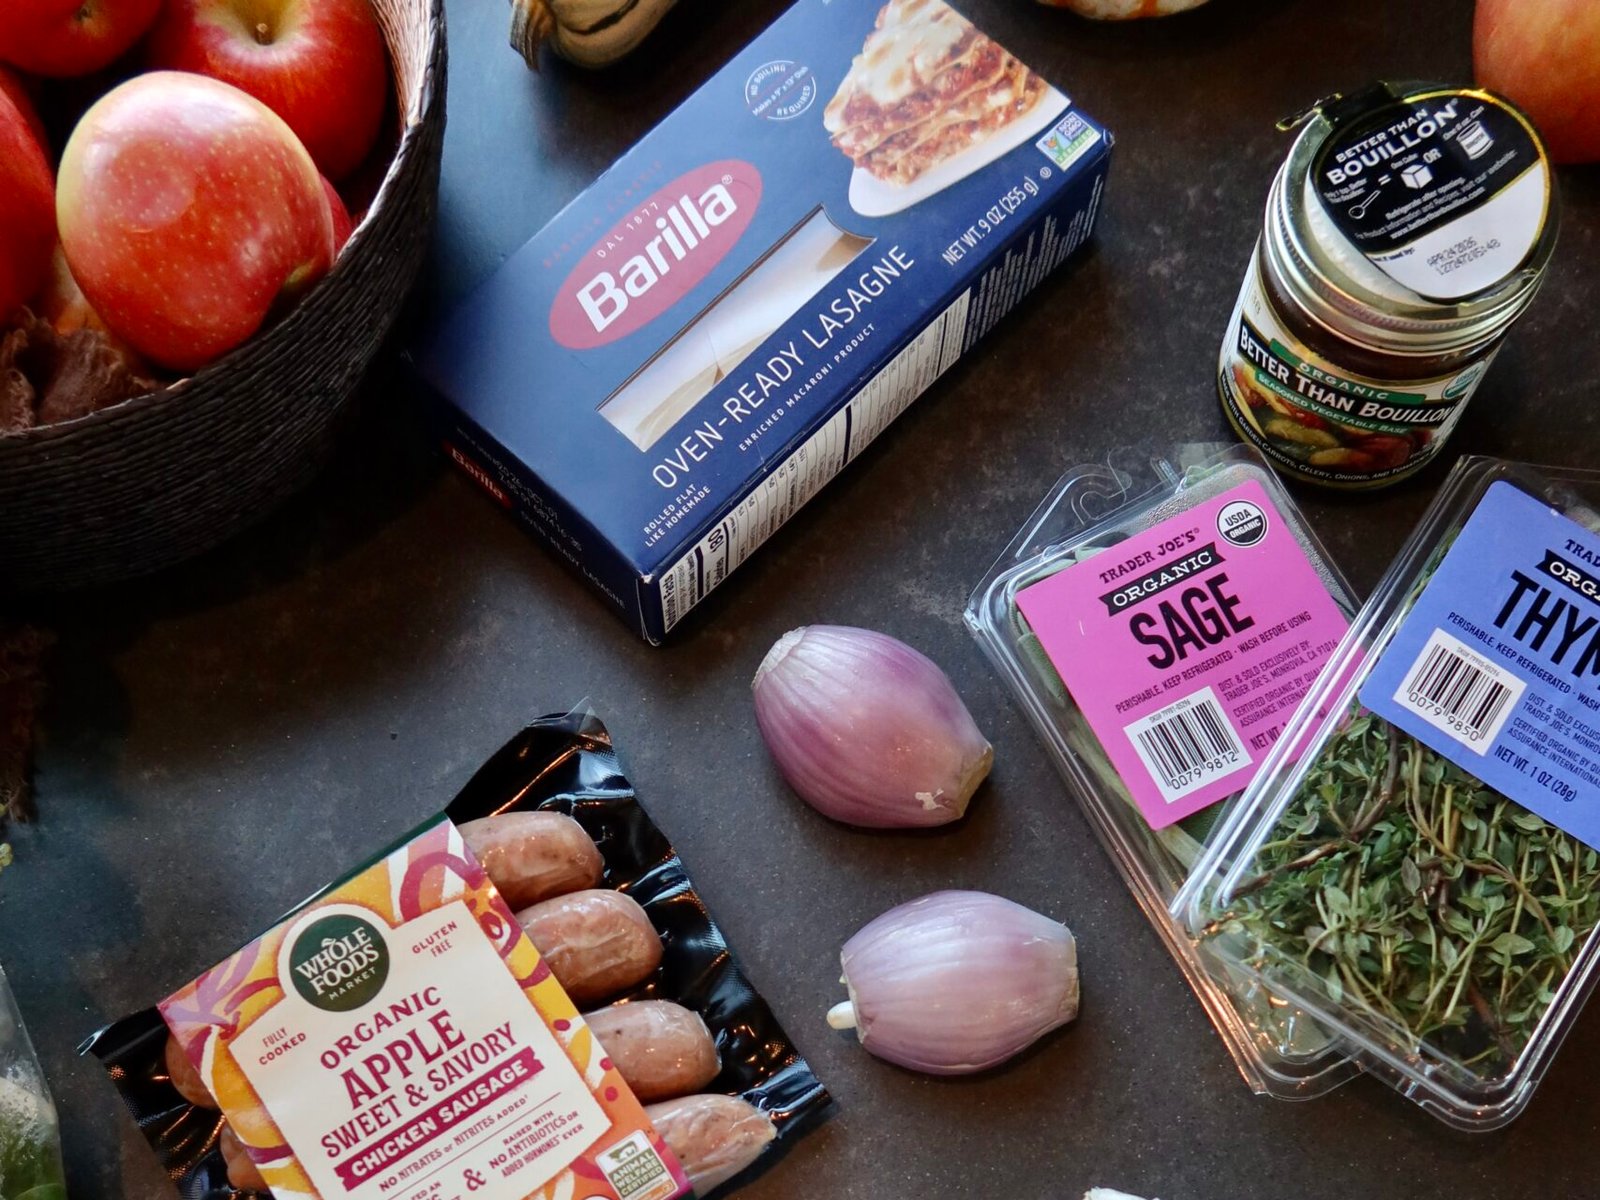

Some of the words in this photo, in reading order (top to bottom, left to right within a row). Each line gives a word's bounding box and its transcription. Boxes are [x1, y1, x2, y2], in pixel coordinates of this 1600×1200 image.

[1326, 103, 1457, 185] BOUILLON
[1335, 132, 1387, 163] BETTER
[1387, 108, 1428, 135] THAN
[1422, 148, 1442, 164] OR
[596, 234, 624, 258] DAL
[626, 201, 659, 230] 1877
[942, 240, 967, 266] NET
[960, 225, 985, 248] WT.
[978, 219, 992, 233] 9
[988, 204, 1007, 227] OZ
[998, 186, 1027, 214] (255
[577, 184, 736, 331] Barilla
[652, 342, 804, 488] OVEN-READY
[802, 245, 914, 349] LASAGNE
[738, 408, 785, 451] ENRICHED
[785, 363, 833, 408] MACARONI
[833, 323, 875, 363] PRODUCT
[1240, 325, 1289, 384] BETTER
[1295, 373, 1355, 412] THAN
[1359, 402, 1454, 423] BOUILLON
[1297, 361, 1388, 399] ORGANIC
[1258, 373, 1308, 407] SEASONED
[1310, 403, 1377, 429] VEGETABLE
[1378, 424, 1408, 434] BASE
[643, 504, 676, 535] ROLLED
[675, 483, 696, 505] FLAT
[644, 527, 666, 547] LIKE
[665, 485, 711, 529] HOMEMADE
[1224, 509, 1252, 527] USDA
[1229, 518, 1261, 539] ORGANIC
[1099, 551, 1156, 584] TRADER
[1157, 530, 1196, 556] JOE'S
[1113, 551, 1212, 607] ORGANIC
[1549, 561, 1600, 601] ORG
[1130, 573, 1254, 669] SAGE
[1115, 684, 1164, 714] PERISHABLE,
[1161, 674, 1181, 690] KEEP
[1181, 650, 1233, 681] REFRIGERATED
[1237, 637, 1261, 653] WASH
[1258, 622, 1289, 644] BEFORE
[1286, 610, 1312, 629] USING
[1223, 683, 1251, 702] TRADER
[1306, 650, 1318, 661] CA
[1241, 665, 1261, 681] SOLD
[1258, 644, 1300, 672] EXCLUSIVELY
[1495, 642, 1518, 659] KEEP
[1516, 655, 1571, 694] REFRIGERATED
[1232, 696, 1266, 718] CERTIFIED
[1264, 681, 1295, 703] ORGANIC
[1293, 677, 1304, 688] BY
[1239, 703, 1278, 728] ASSURANCE
[1408, 691, 1443, 717] 0079
[1447, 715, 1481, 742] 9850
[1523, 701, 1551, 723] TRADER
[1553, 707, 1574, 725] SOLD
[1249, 732, 1269, 751] NET
[1507, 727, 1549, 757] ASSURANCE
[1513, 716, 1549, 743] CERTIFIED
[1547, 738, 1581, 762] ORGANIC
[1578, 756, 1591, 768] BY
[1169, 767, 1202, 790] 0079
[1206, 749, 1238, 772] 9812
[1494, 744, 1516, 763] NET
[1512, 755, 1530, 774] WT.
[1529, 766, 1538, 778] 1
[1537, 771, 1553, 788] OZ
[1550, 779, 1578, 802] (28g)
[295, 927, 371, 979] WHOLE
[412, 921, 458, 954] GLUTEN
[430, 939, 452, 957] FREE
[310, 943, 379, 995] FOODS
[328, 966, 376, 1001] MARKET
[258, 1029, 307, 1066] COOKED
[262, 1027, 291, 1051] FULLY
[320, 986, 441, 1068] ORGANIC
[341, 1010, 465, 1109] APPLE
[321, 1094, 402, 1158] SWEET
[400, 1077, 431, 1109] &
[427, 1022, 516, 1092] SAVORY
[351, 1117, 437, 1176] CHICKEN
[439, 1059, 528, 1123] SAUSAGE
[488, 1153, 507, 1169] NO
[507, 1115, 567, 1158] ANTIBIOTICS
[502, 1124, 532, 1146] RAISED
[532, 1110, 554, 1126] WITH
[379, 1176, 398, 1192] NO
[397, 1148, 443, 1180] NITRATES
[453, 1115, 495, 1146] NITRITES
[501, 1158, 524, 1178] ADDED
[562, 1123, 584, 1140] EVER
[613, 1152, 655, 1182] ANIMAL
[615, 1158, 659, 1188] WELFARE
[429, 1182, 441, 1192] AN
[459, 1163, 488, 1193] &
[621, 1165, 663, 1196] CERTIFIED
